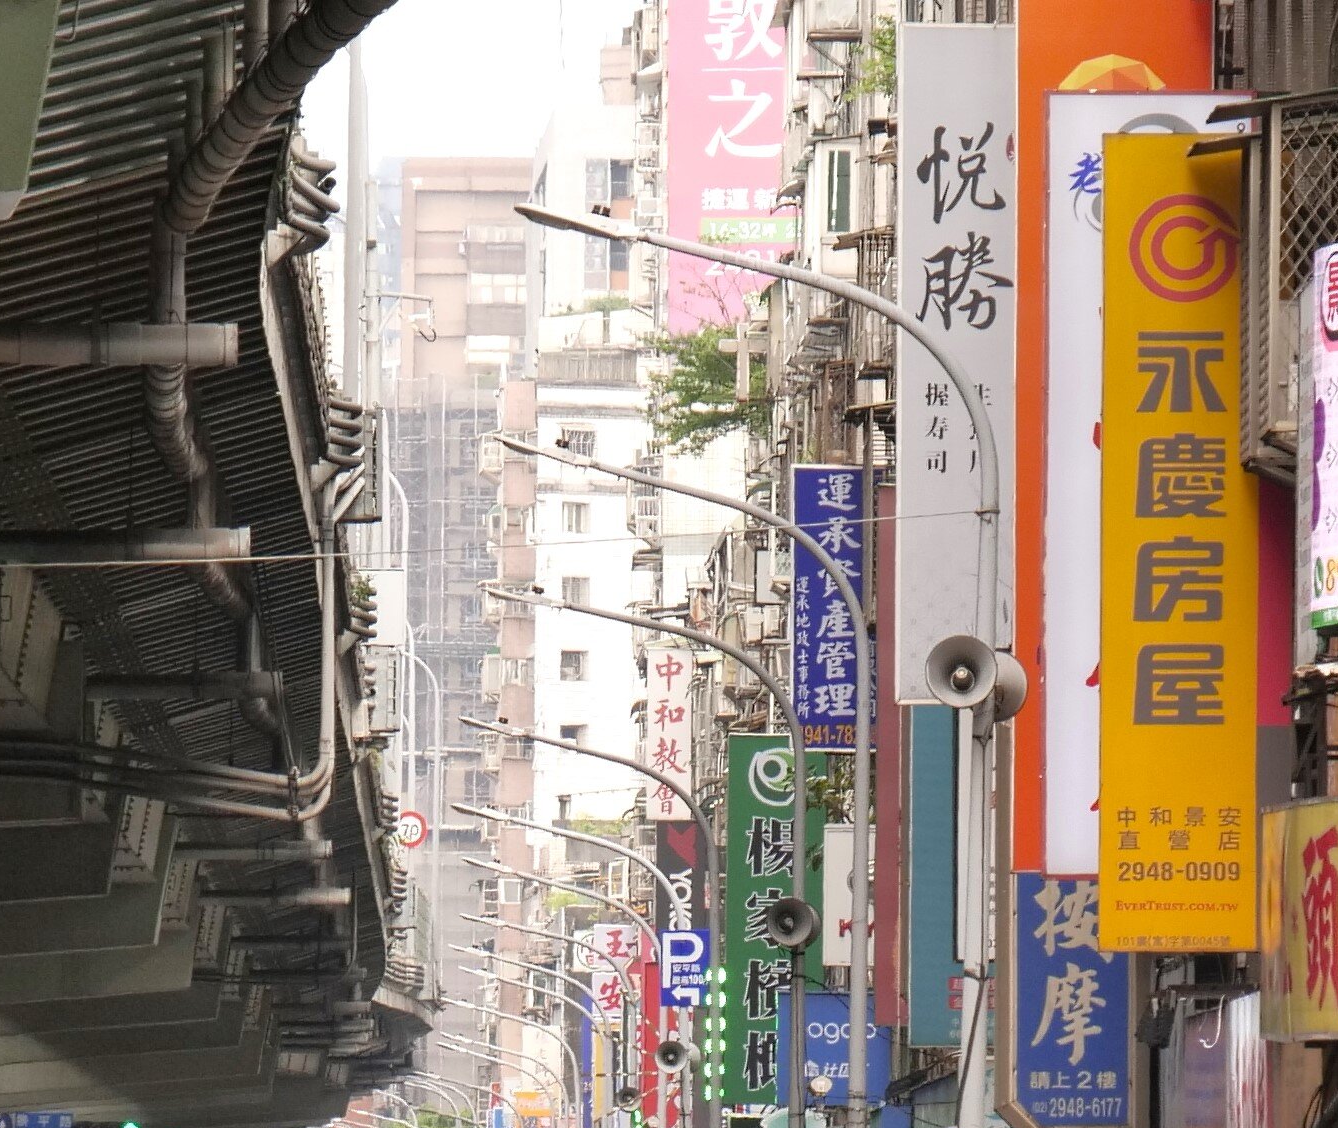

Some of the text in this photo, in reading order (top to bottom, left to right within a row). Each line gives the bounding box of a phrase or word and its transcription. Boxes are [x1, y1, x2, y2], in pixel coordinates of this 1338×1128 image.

[916, 122, 1013, 332] 悅勝
[1133, 331, 1227, 726] 永慶房屋
[1117, 806, 1241, 827] 中和景安
[1118, 830, 1241, 851] 直營店
[1118, 861, 1240, 882] 2948-0909
[663, 932, 704, 989] P
[1032, 880, 1115, 1066] 按摩
